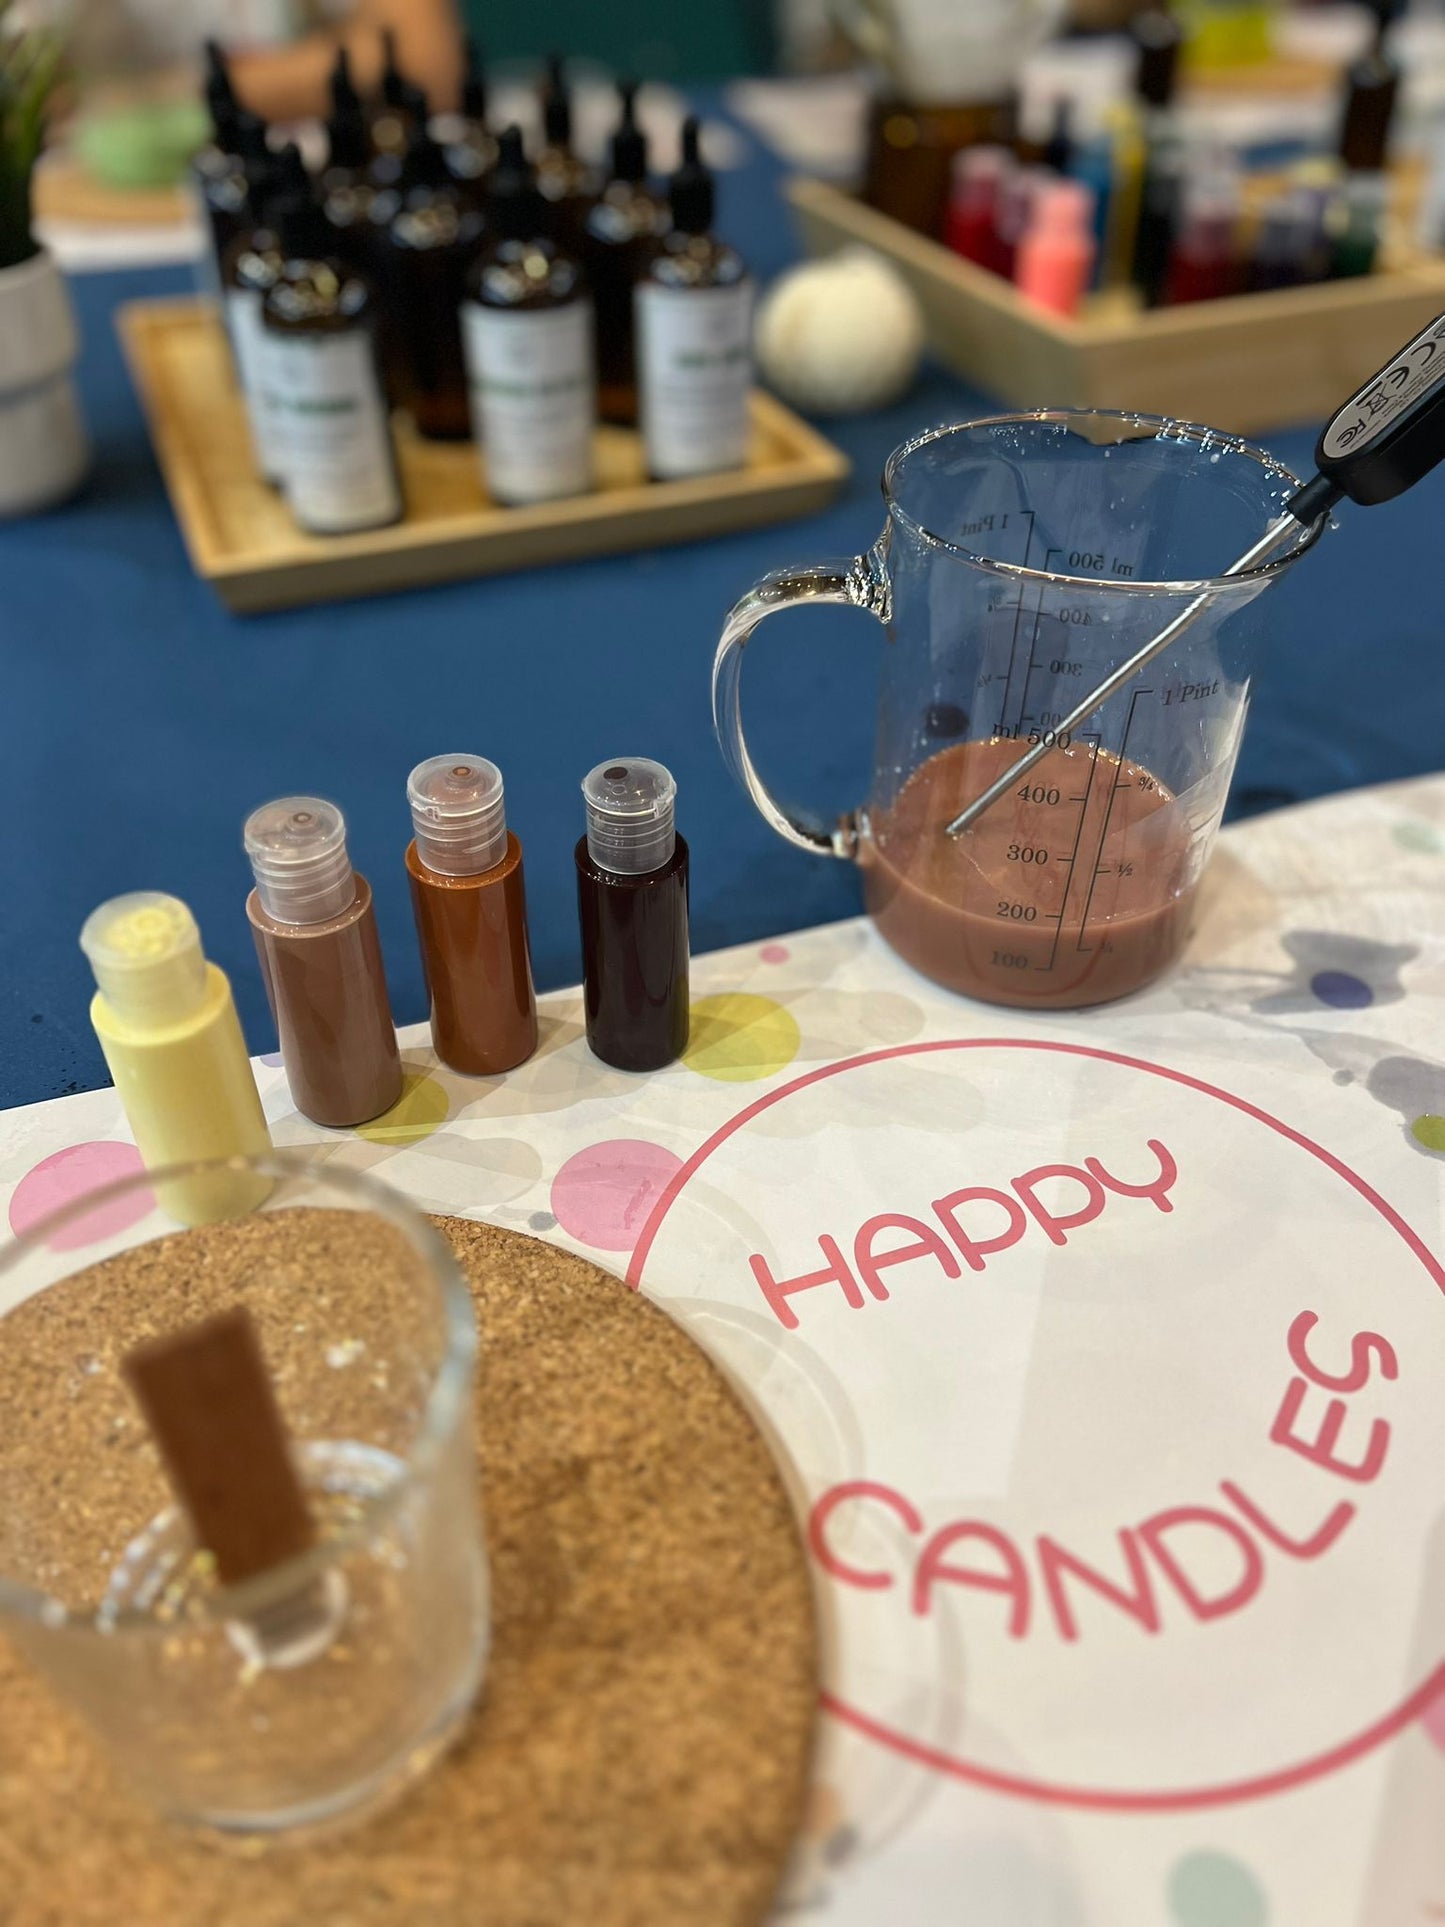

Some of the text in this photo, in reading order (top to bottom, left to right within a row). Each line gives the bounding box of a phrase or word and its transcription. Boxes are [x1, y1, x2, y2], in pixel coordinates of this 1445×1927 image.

[1162, 679, 1219, 706] 1 Pint
[992, 723, 1071, 750] ml 500
[1017, 784, 1060, 806] 400
[1006, 844, 1048, 865] 300
[996, 901, 1037, 922] 200
[991, 950, 1029, 970] 100
[748, 1138, 1178, 1329] HAPPY
[806, 1310, 1399, 1643] CANDLES
